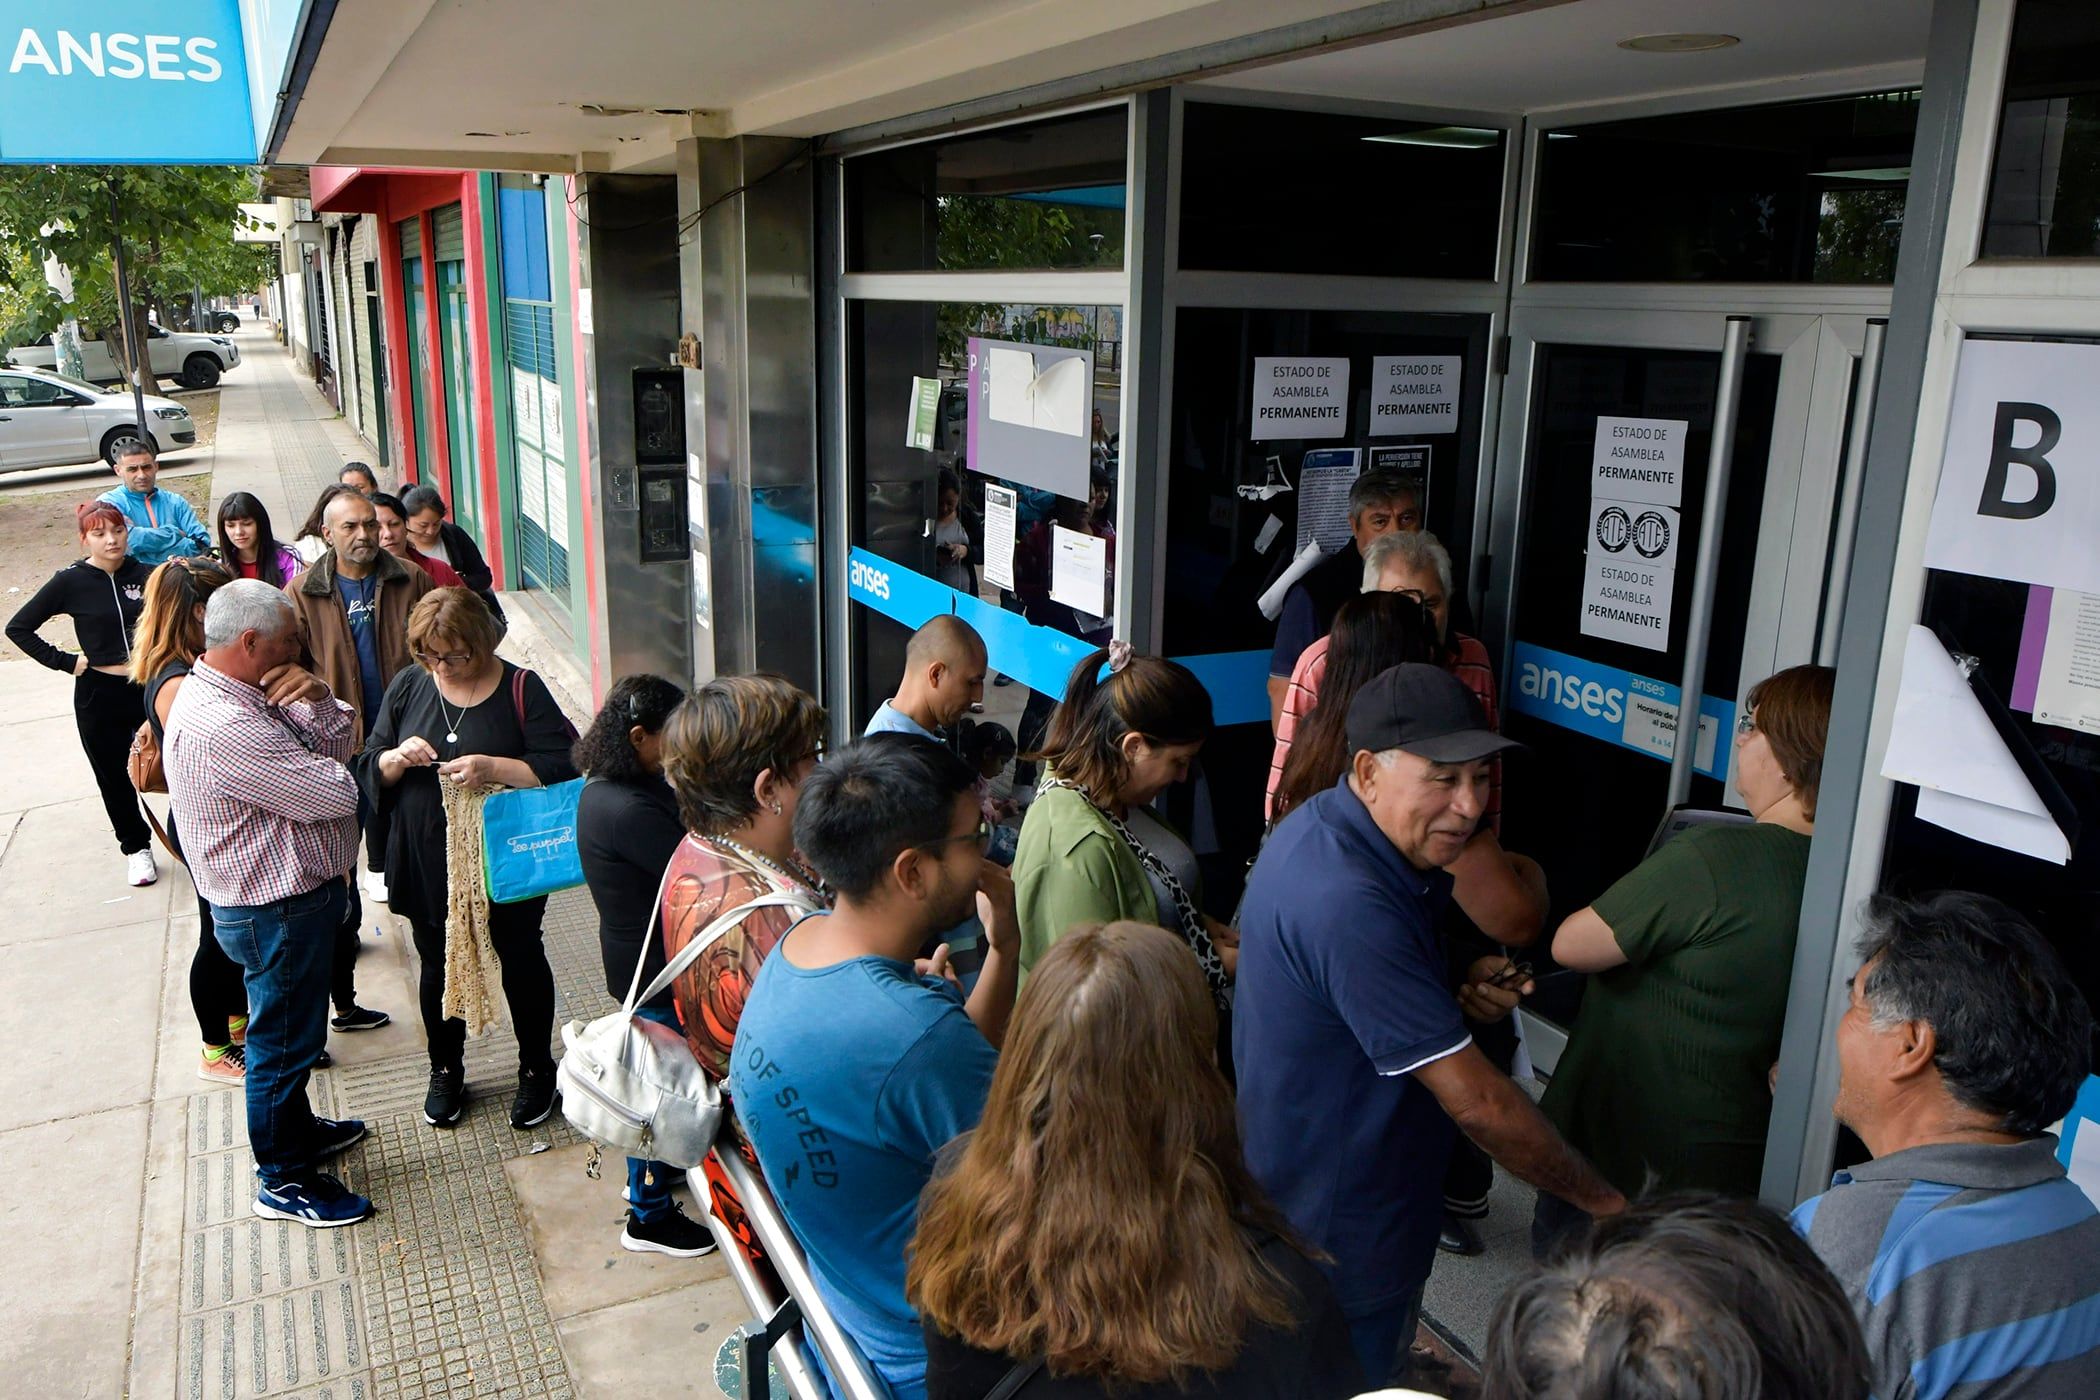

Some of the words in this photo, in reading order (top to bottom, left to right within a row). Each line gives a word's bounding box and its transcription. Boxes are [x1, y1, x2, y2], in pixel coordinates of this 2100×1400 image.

[9, 28, 222, 83] ANSES
[1273, 366, 1314, 378] ESTADO
[1317, 366, 1331, 378] DE
[1390, 365, 1429, 376] ESTADO
[1431, 364, 1444, 375] DE
[1273, 386, 1329, 398] ASAMBLEA
[1390, 384, 1442, 395] ASAMBLEA
[1260, 406, 1340, 419] PERMANENTE
[1377, 403, 1452, 416] PERMANENTE
[1612, 426, 1652, 440] ESTADO
[1654, 429, 1667, 441] DE
[1610, 446, 1665, 461] ASAMBLEA
[1977, 401, 2062, 520] B
[1598, 465, 1675, 484] PERMANENTE
[851, 560, 890, 601] anses
[1601, 567, 1638, 583] ESTADO
[1641, 574, 1654, 586] DE
[1600, 587, 1652, 606] ASAMBLEA
[1587, 604, 1662, 629] PERMANENTE
[1519, 662, 1624, 724] anses
[1631, 678, 1666, 697] anses
[1636, 702, 1663, 717] Horario
[1663, 711, 1674, 720] de
[1652, 719, 1659, 727] al
[748, 1046, 782, 1081] OF
[774, 1086, 839, 1189] SPEED
